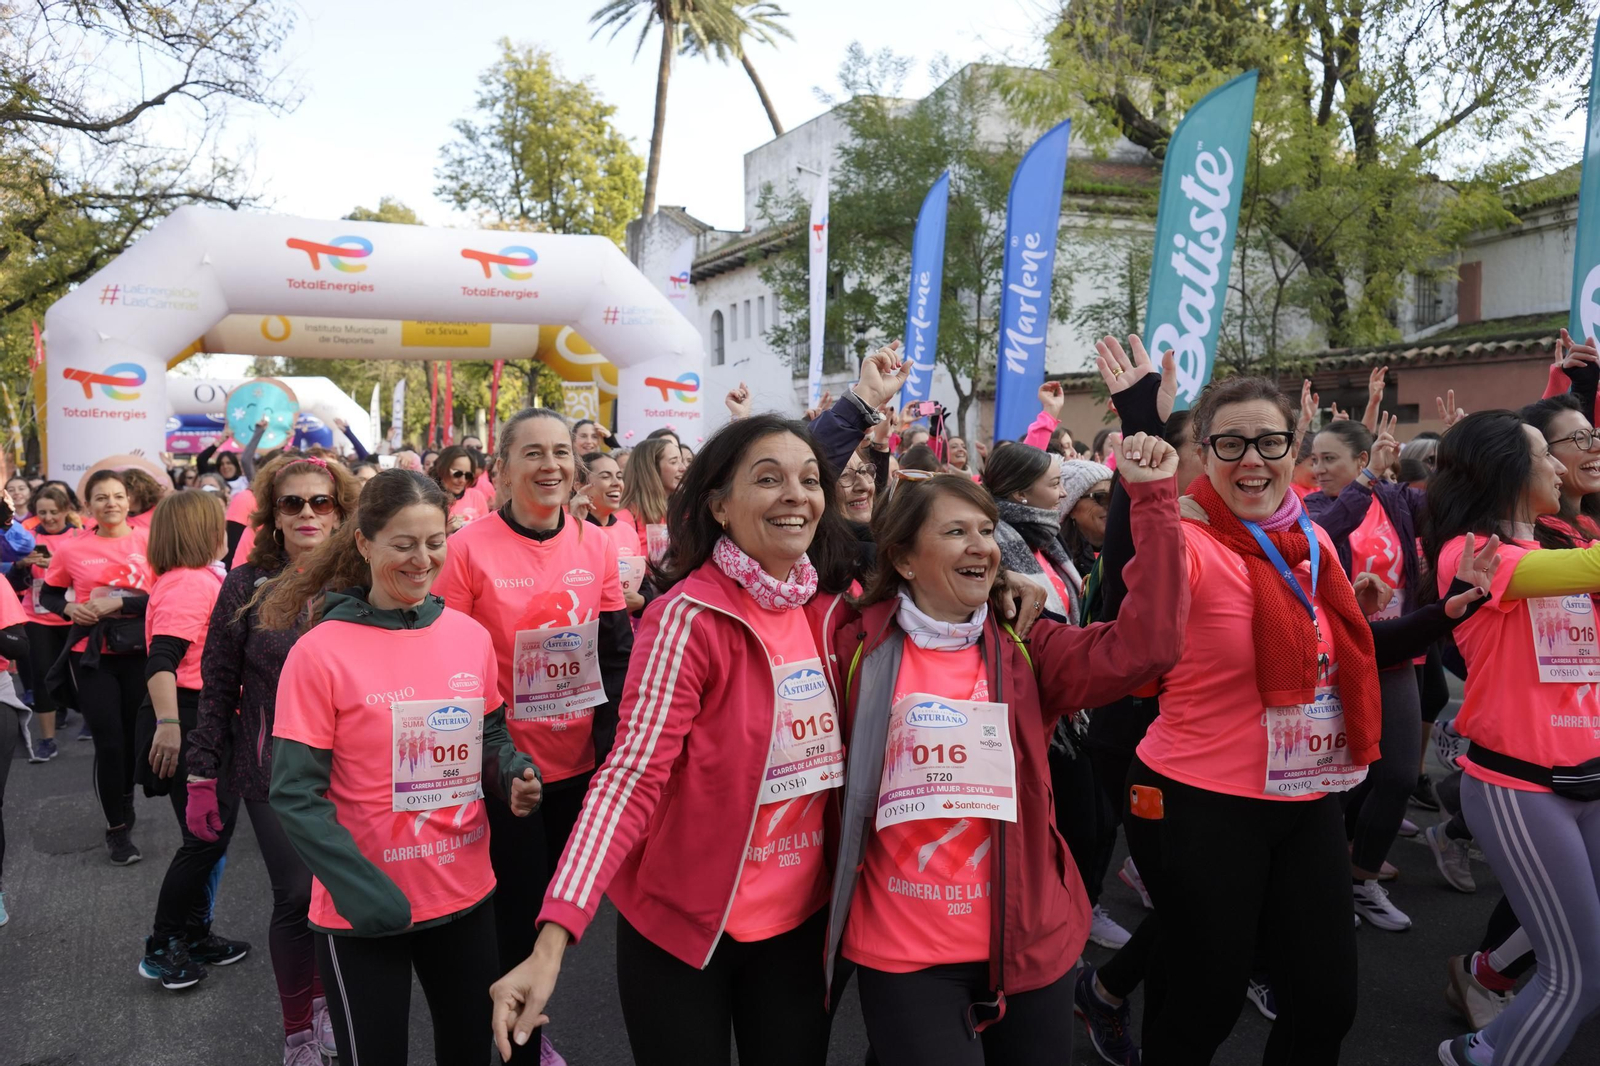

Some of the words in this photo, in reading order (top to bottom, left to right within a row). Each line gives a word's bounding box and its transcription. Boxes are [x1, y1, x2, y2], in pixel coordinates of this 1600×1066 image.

[1151, 146, 1234, 404] Batiste
[287, 278, 374, 293] TotalEnergies
[462, 286, 539, 300] TotalEnergies
[1004, 232, 1048, 375] Marlene
[304, 323, 342, 333] Instituto
[344, 324, 388, 335] Municipal
[905, 270, 935, 397] Marlene
[333, 336, 375, 345] Deportes
[62, 407, 147, 421] TotalEnergies
[494, 577, 535, 589] OYSHO
[1569, 626, 1594, 642] 016
[546, 661, 580, 678] 016
[1550, 668, 1579, 677] OYSHO
[366, 686, 415, 705] OYSHO
[783, 680, 826, 697] ASTURIANA
[528, 693, 549, 701] CARRERA
[525, 703, 556, 713] OYSHO
[1307, 704, 1343, 715] ASTURIAN
[909, 711, 964, 723] ASTURIANA
[791, 712, 834, 741] 016
[1309, 732, 1347, 753] 016
[433, 743, 469, 763] 016
[805, 743, 825, 757] 5719
[912, 744, 967, 765] 016
[805, 760, 813, 768] LA
[813, 756, 834, 765] MUJER
[1316, 756, 1333, 767] 6088
[443, 768, 460, 778] 5645
[926, 772, 953, 783] 5720
[411, 782, 435, 790] CARRERA
[888, 788, 915, 800] CARRERA
[937, 785, 961, 793] MUJER
[966, 786, 994, 794] SEVILLA
[407, 793, 442, 805] OYSHO
[884, 801, 926, 818] OYSHO
[955, 801, 1000, 811] Santander
[383, 842, 434, 863] CARRERA
[436, 838, 449, 854] DE
[450, 835, 461, 850] LA
[778, 835, 792, 852] DE
[794, 832, 809, 849] LA
[437, 852, 455, 866] 2025
[778, 852, 801, 868] 2025
[887, 876, 942, 900] CARRERA
[945, 885, 963, 900] DE
[966, 883, 983, 899] LA
[947, 902, 972, 916] 2025
